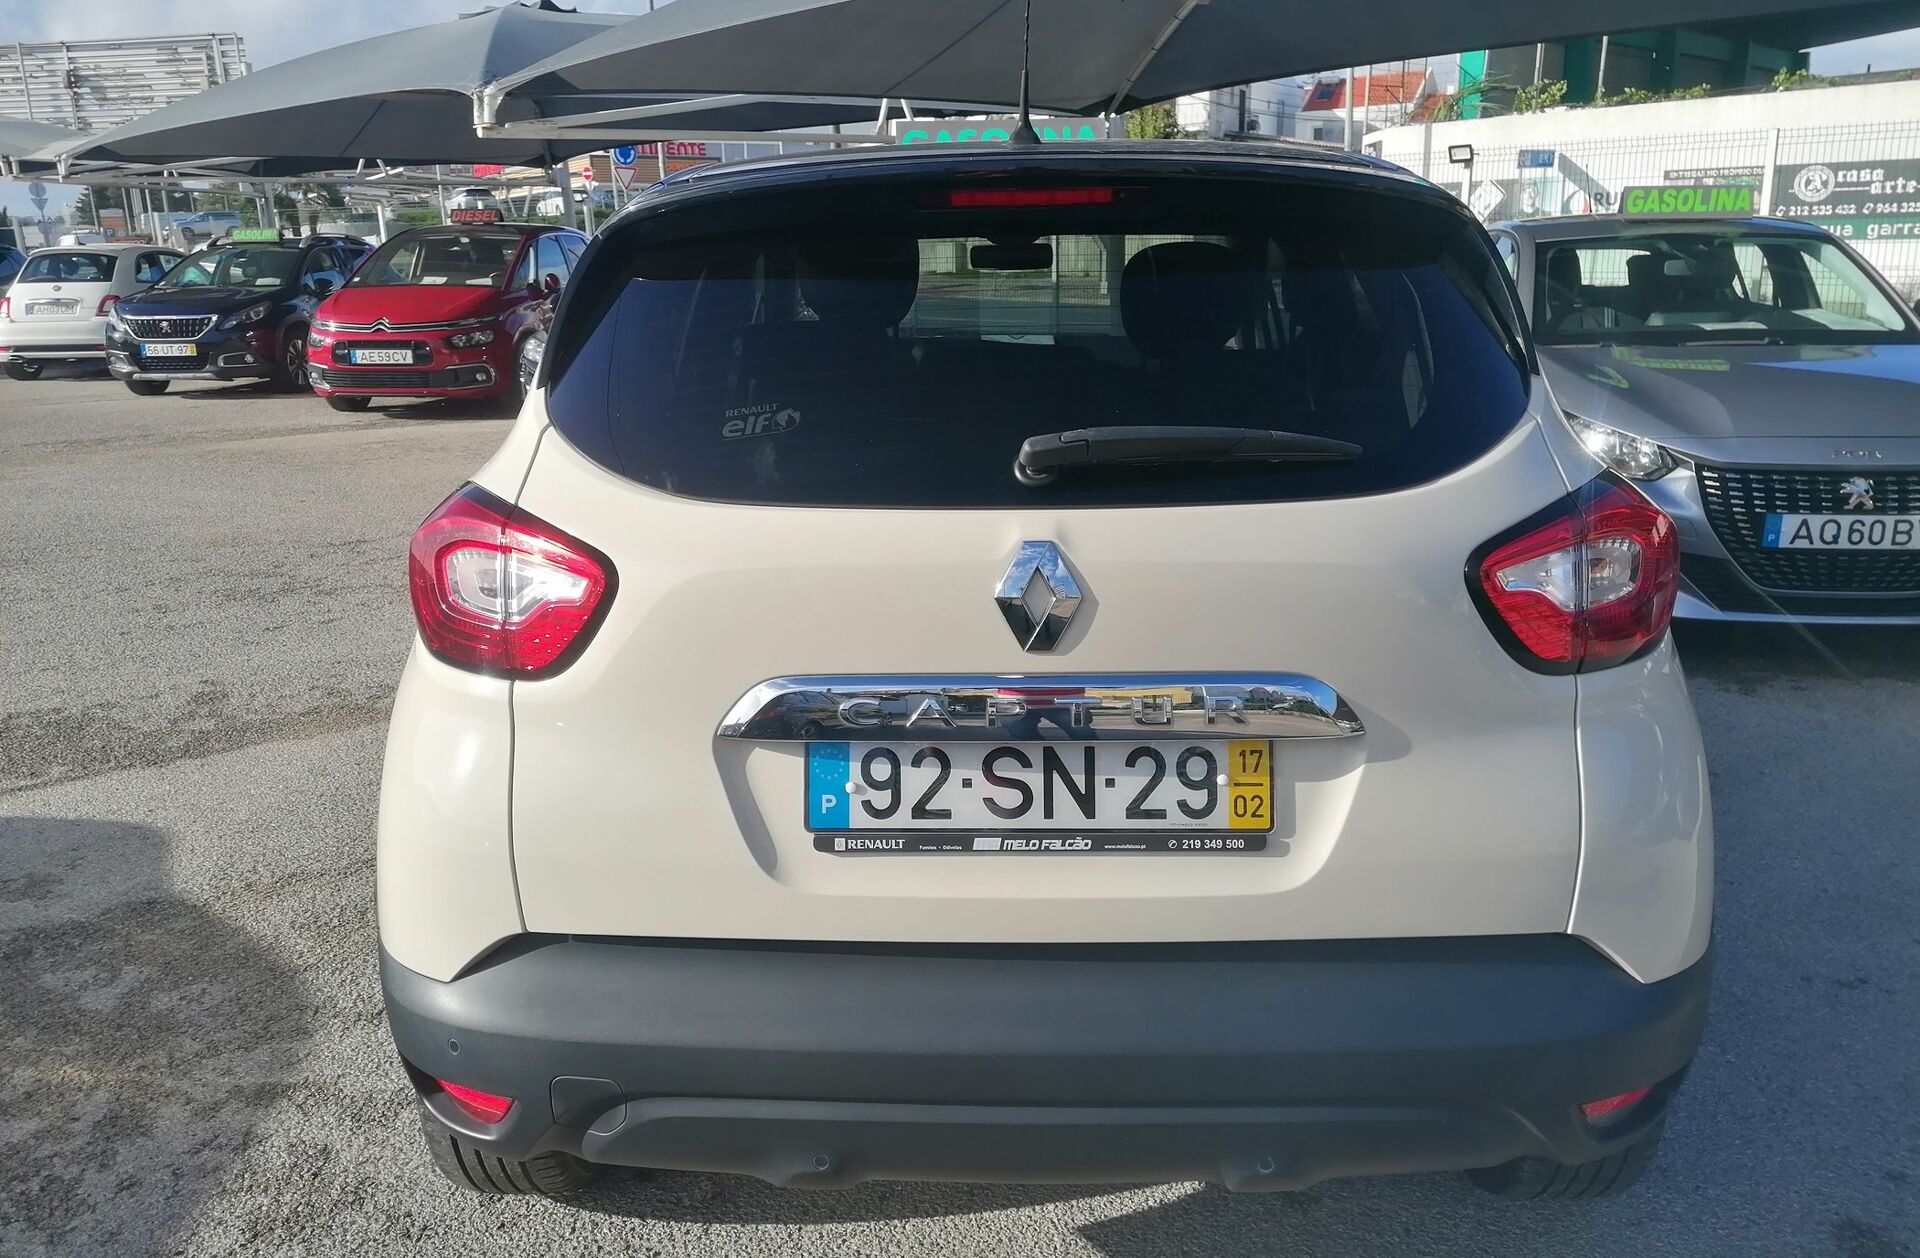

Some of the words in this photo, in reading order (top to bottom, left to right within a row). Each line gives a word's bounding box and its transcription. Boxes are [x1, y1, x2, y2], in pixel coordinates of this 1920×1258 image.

[1626, 187, 1750, 214] GASOLINA
[452, 209, 498, 221] DIESEL
[1788, 205, 1810, 216] 212
[232, 230, 278, 241] GASOLINA
[360, 351, 408, 363] AE59CV
[725, 403, 779, 418] RENAULT
[721, 413, 773, 438] elf
[1789, 518, 1920, 547] AQ60B
[838, 697, 1250, 728] CAPTUR
[1238, 749, 1263, 774] 17
[821, 794, 838, 814] P
[1233, 794, 1265, 819] 02
[848, 839, 906, 850] RENAULT
[1003, 839, 1040, 851] MELO
[1182, 839, 1201, 849] 219
[1203, 839, 1223, 849] 349
[1225, 839, 1245, 849] 500
